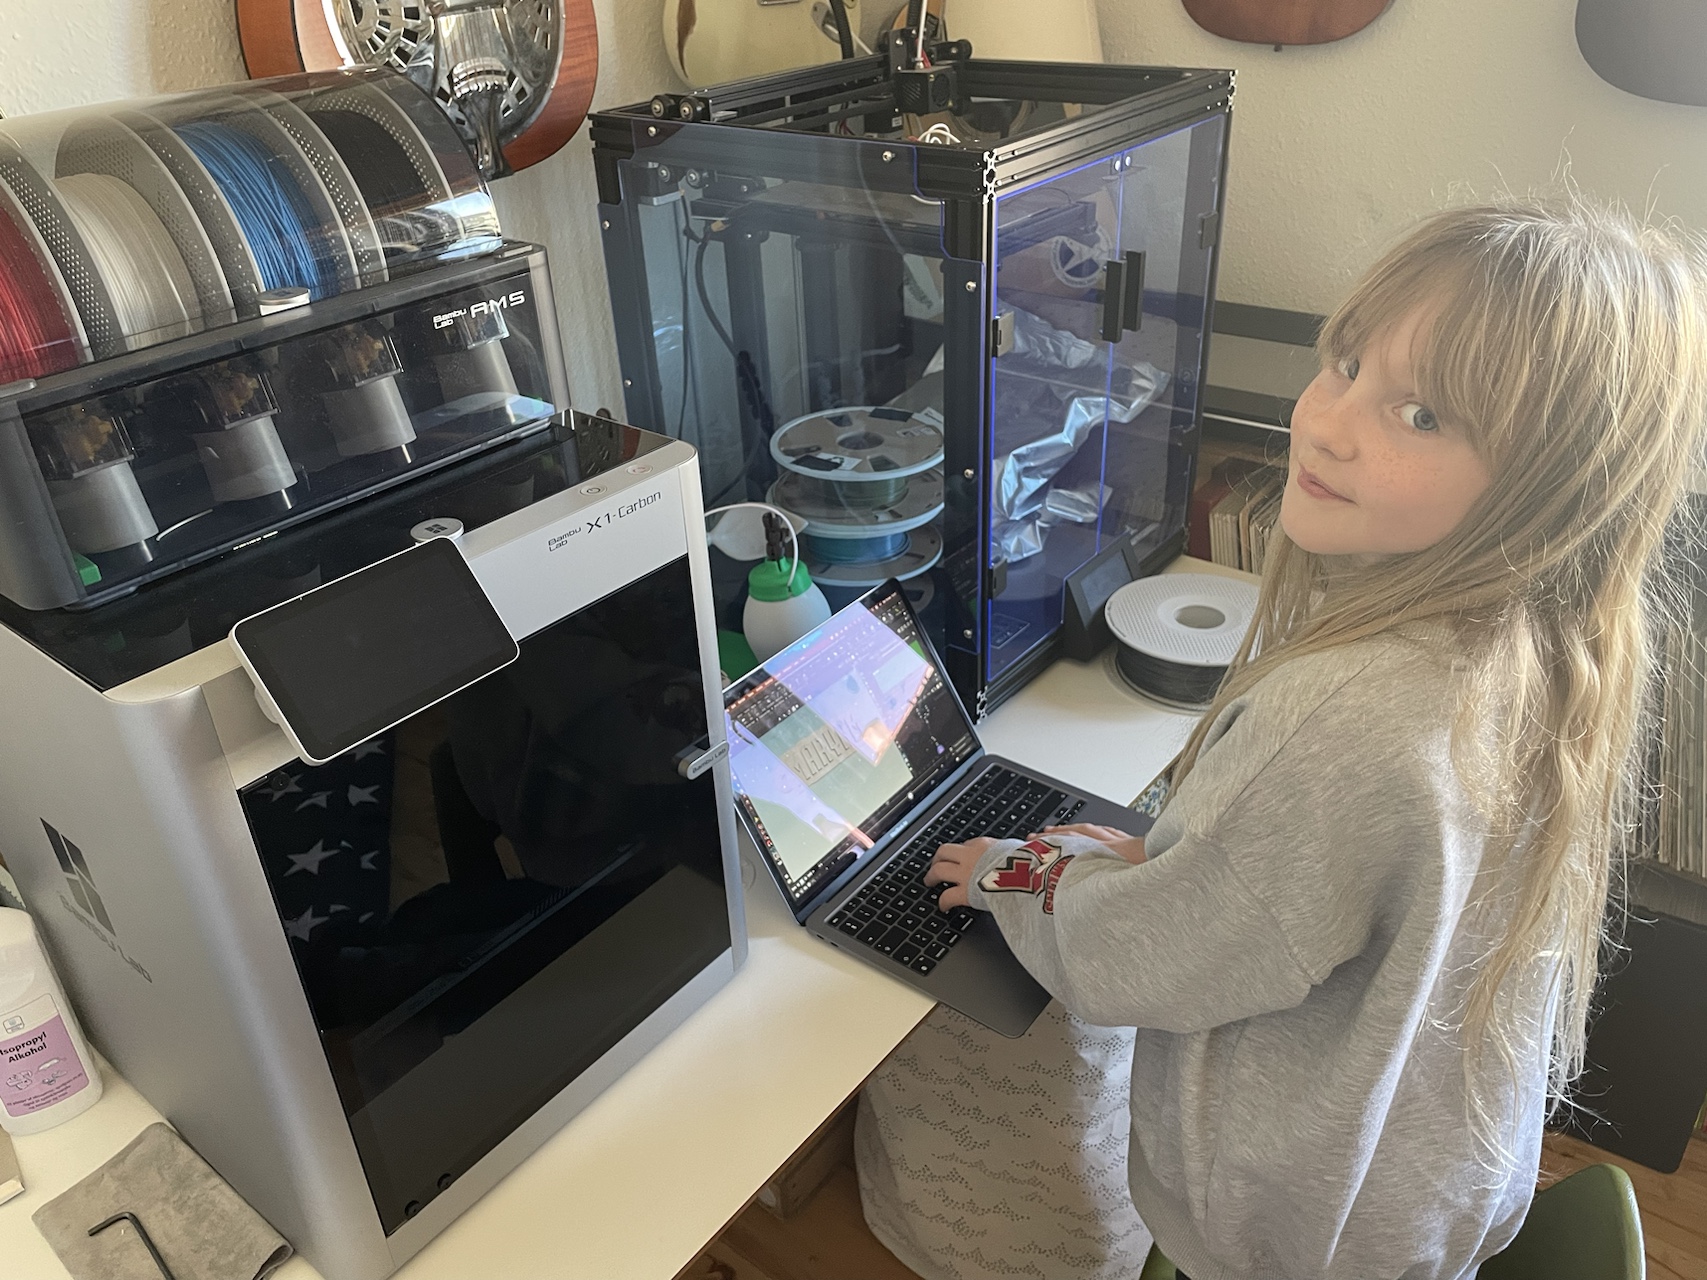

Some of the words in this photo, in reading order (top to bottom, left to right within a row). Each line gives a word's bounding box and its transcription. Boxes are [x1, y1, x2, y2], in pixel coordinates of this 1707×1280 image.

[470, 290, 526, 318] AMS
[433, 308, 468, 323] Bambu
[433, 319, 454, 330] Lab
[548, 526, 582, 546] Bambu
[548, 539, 568, 552] Lab
[8, 1042, 47, 1063] Alkohol
